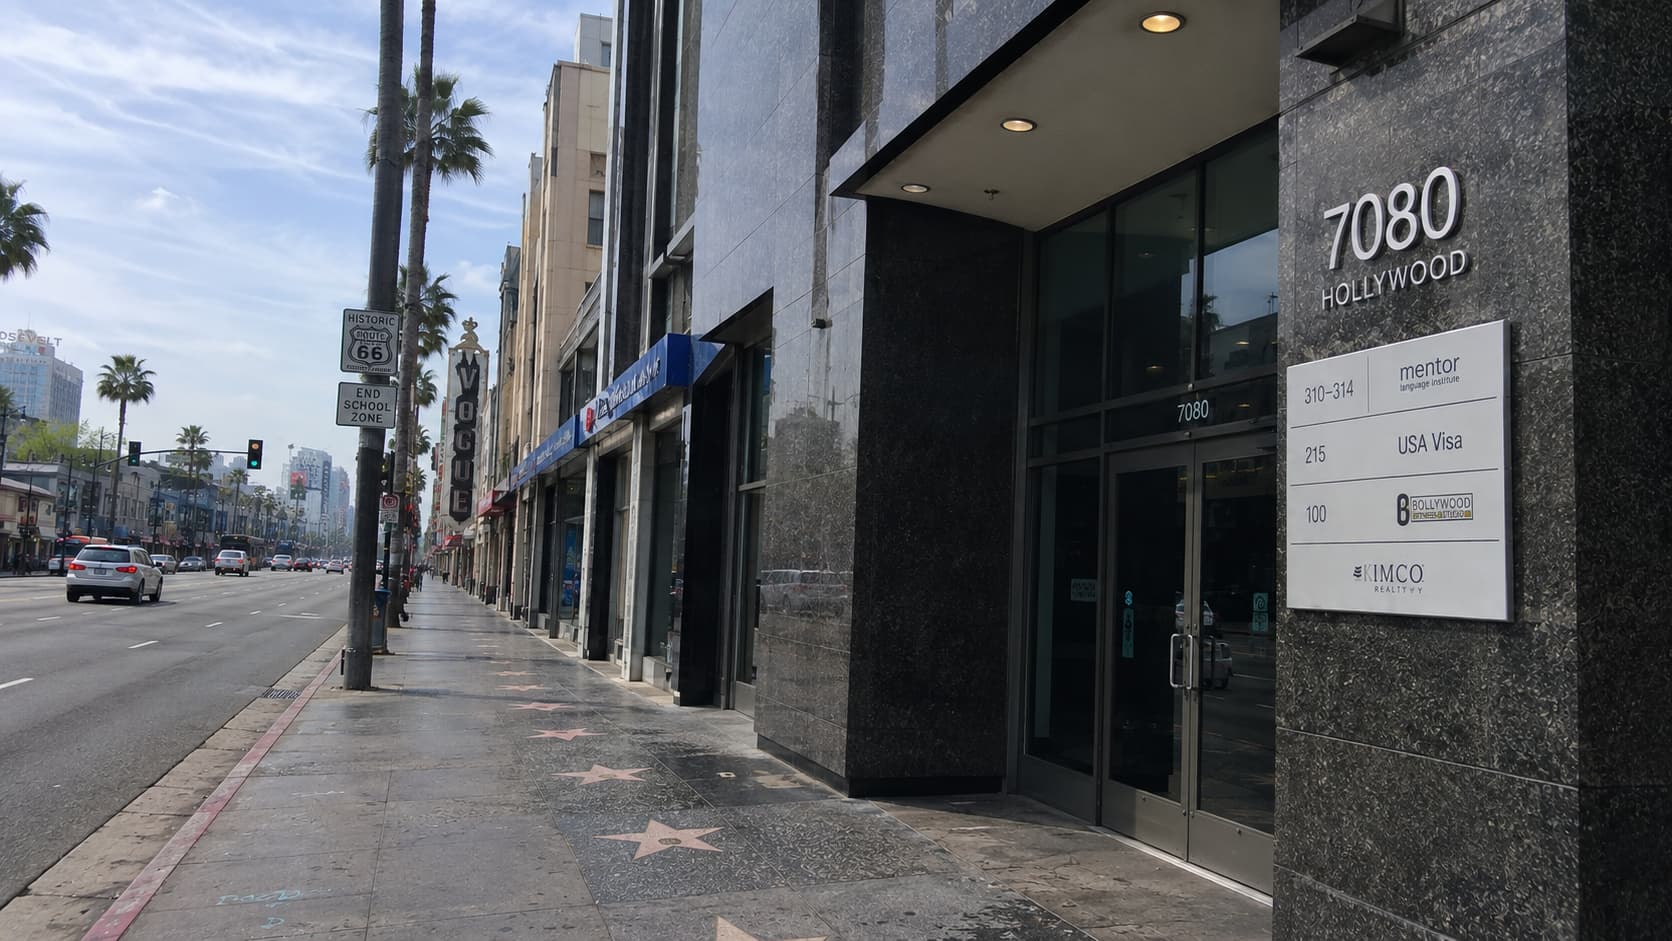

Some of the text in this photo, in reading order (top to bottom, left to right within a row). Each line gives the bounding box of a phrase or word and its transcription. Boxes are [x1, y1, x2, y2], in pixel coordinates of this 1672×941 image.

[1323, 166, 1461, 270] 7080
[1322, 250, 1467, 310] HOLLYWOOD
[348, 313, 395, 326] HISTORIC
[357, 345, 382, 360] 66
[1400, 356, 1460, 381] mentor
[356, 387, 381, 399] END
[343, 399, 391, 412] SCHOOL
[351, 411, 383, 424] ZONE
[1177, 399, 1209, 423] 7080
[451, 358, 479, 516] VOGUE
[1305, 431, 1463, 464] 215 USA Visa
[1306, 504, 1326, 523] 100
[1412, 497, 1471, 511] BOLLYWOOD
[1364, 563, 1423, 584] KIMCO
